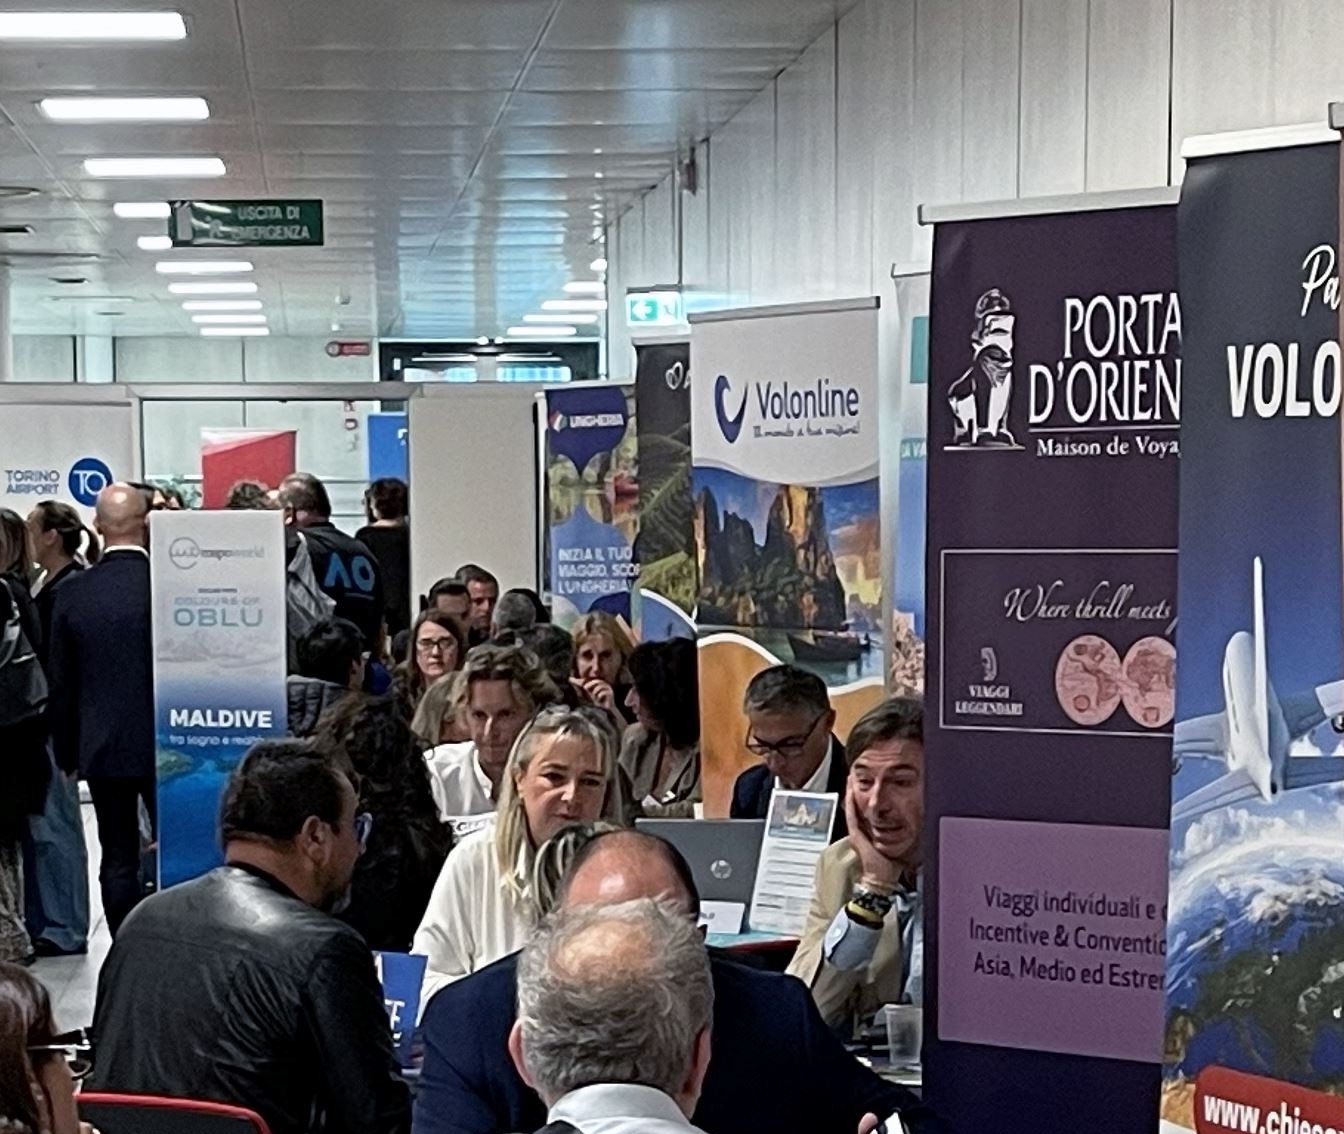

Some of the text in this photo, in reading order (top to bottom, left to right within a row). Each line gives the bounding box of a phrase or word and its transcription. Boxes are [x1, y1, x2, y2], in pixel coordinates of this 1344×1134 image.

[237, 205, 300, 220] USCITA DI
[1063, 292, 1182, 358] PORTA
[1028, 358, 1182, 424] D'ORIEN
[1226, 340, 1342, 418] VOLO
[755, 378, 859, 420] Volonline
[1036, 436, 1102, 457] Maison
[1106, 435, 1129, 455] de
[4, 470, 61, 482] TORINO
[6, 483, 60, 495] AIRPORT
[1003, 579, 1072, 622] Where
[1074, 580, 1134, 620] thrill
[174, 608, 263, 627] OBLU
[968, 685, 1010, 698] VIAGGI
[169, 709, 273, 728] MALDIVE
[983, 884, 1156, 919] Viaggi individuali e
[969, 917, 1050, 946] Incentive
[1054, 924, 1070, 947] &
[1020, 955, 1076, 982] Medio
[1080, 963, 1104, 985] ed
